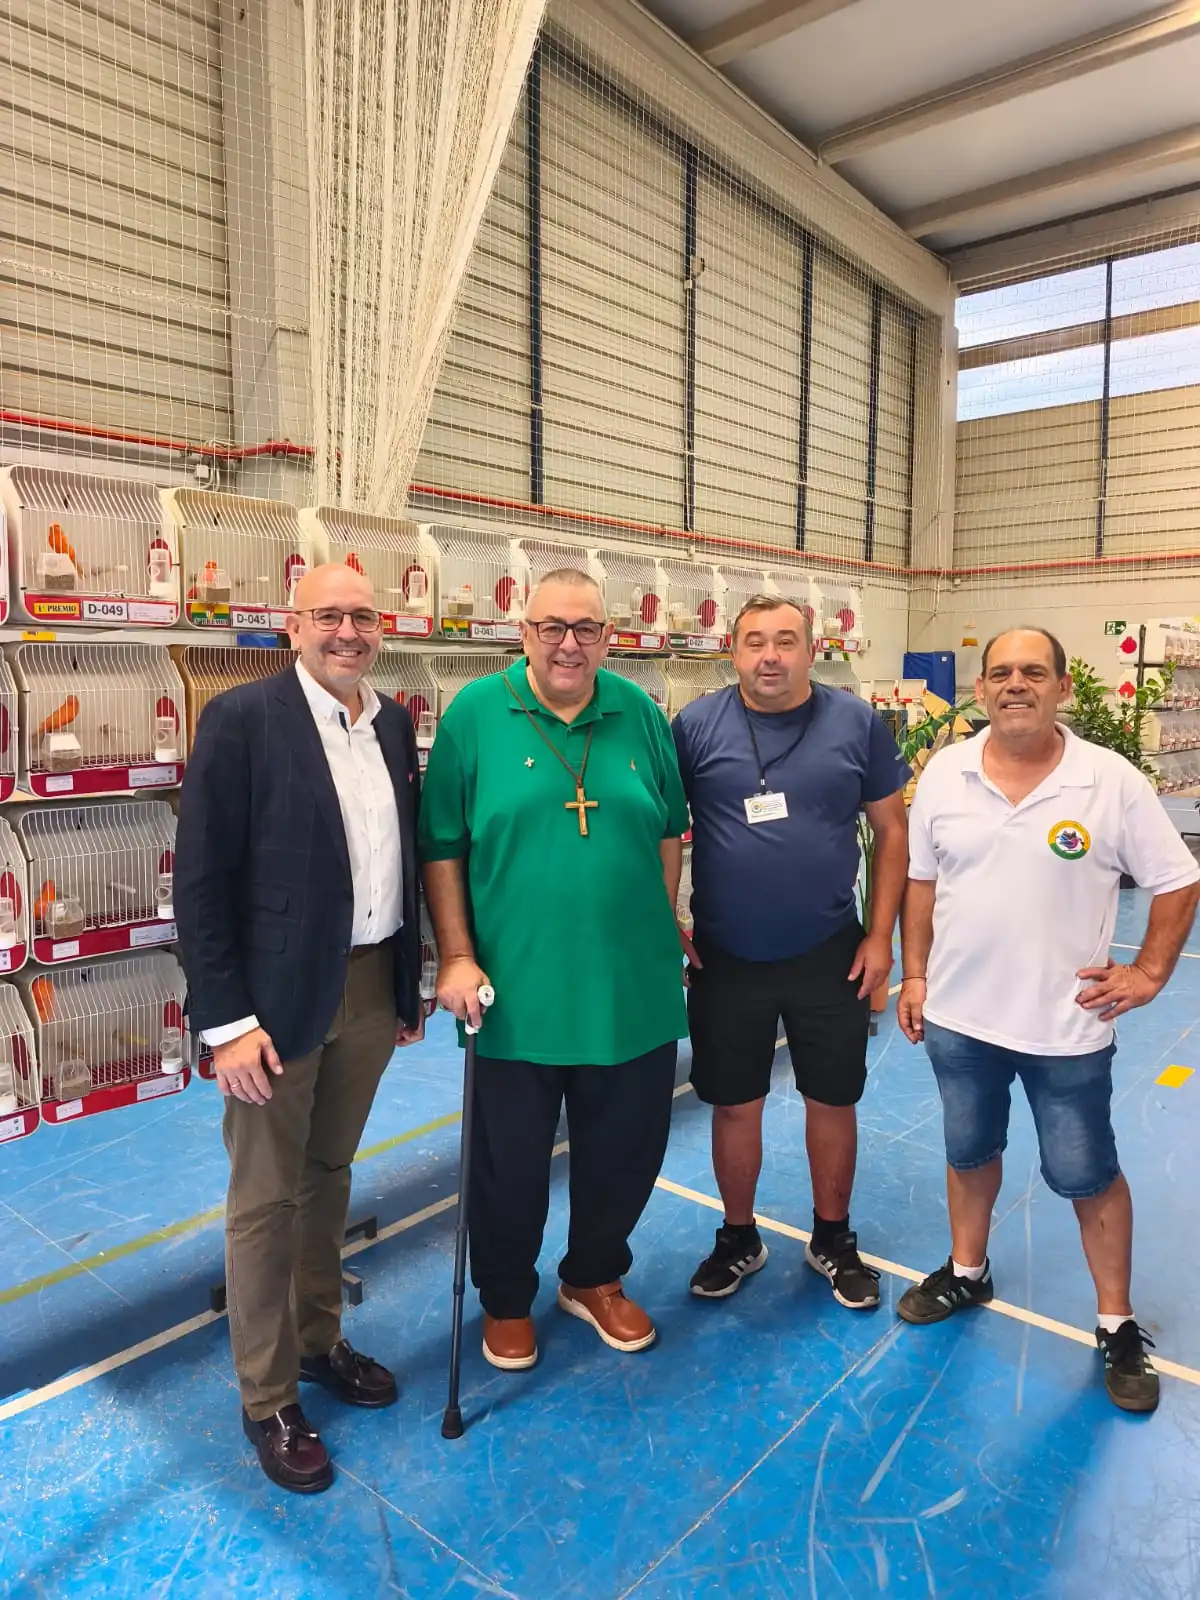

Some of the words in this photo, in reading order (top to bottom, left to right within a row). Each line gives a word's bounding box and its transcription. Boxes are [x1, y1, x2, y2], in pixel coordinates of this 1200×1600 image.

[47, 603, 77, 613] PREMIO
[88, 603, 123, 616] D-049
[236, 613, 266, 625] D-045
[474, 626, 494, 637] D-043
